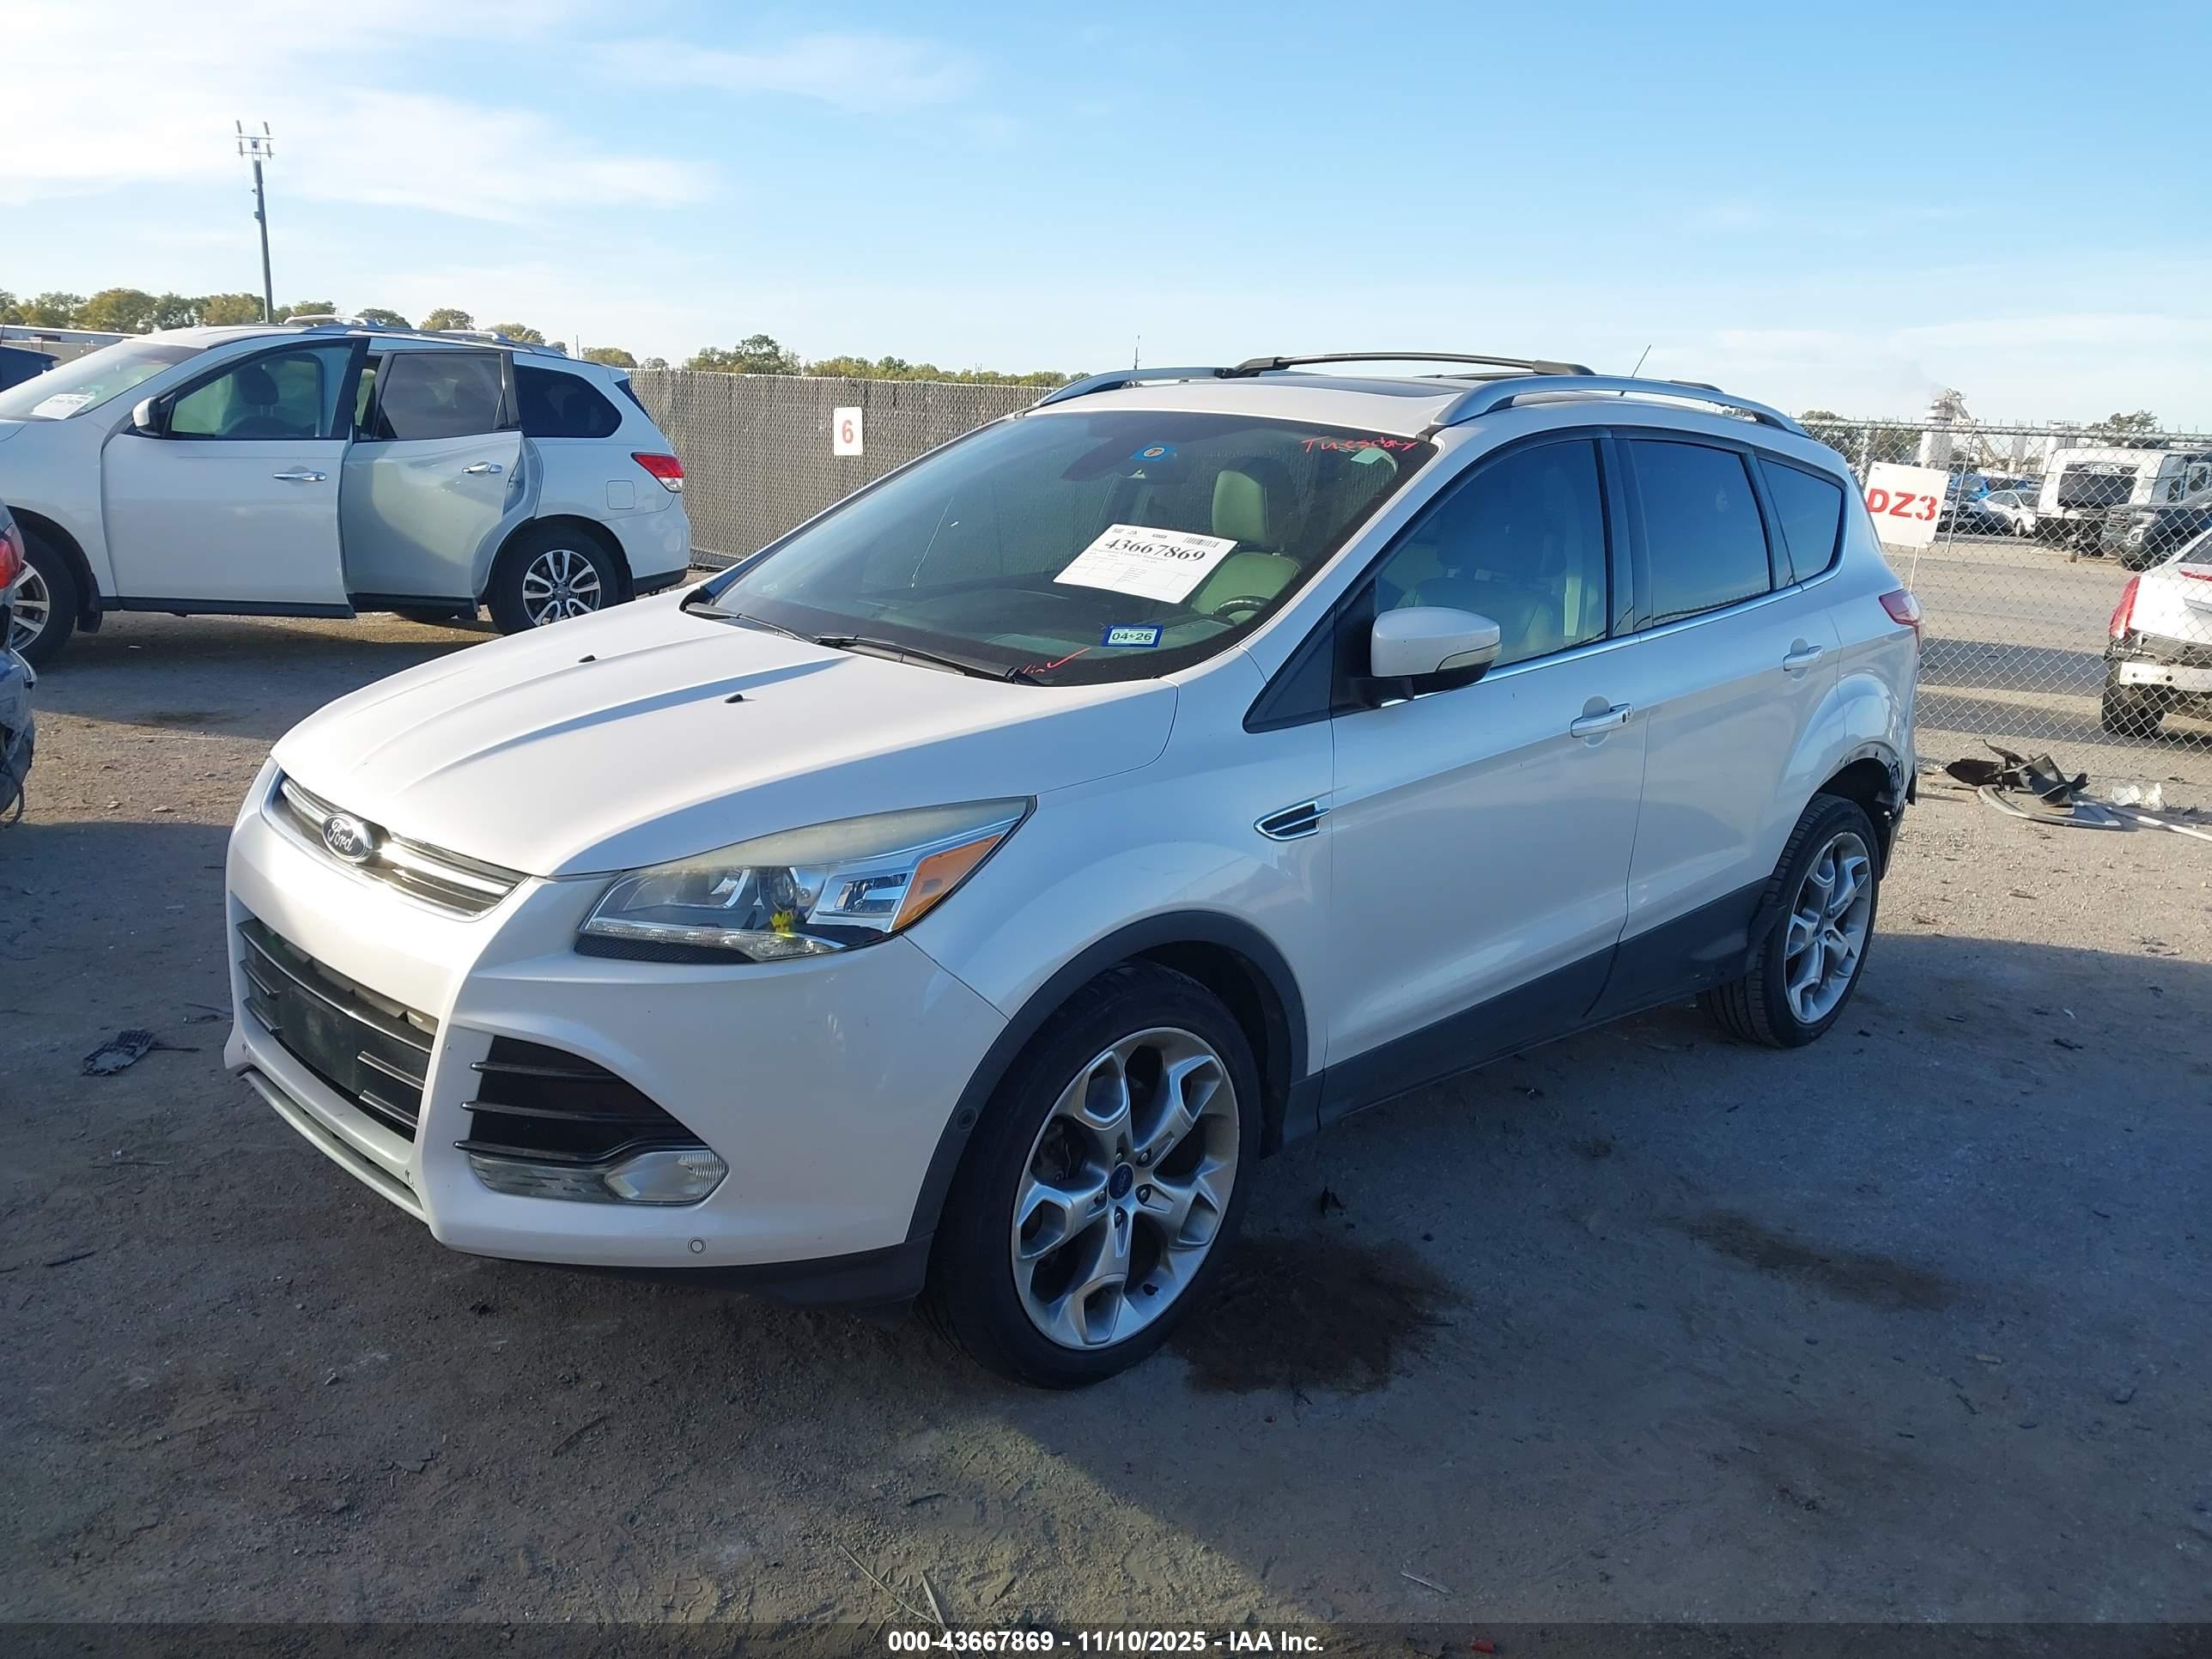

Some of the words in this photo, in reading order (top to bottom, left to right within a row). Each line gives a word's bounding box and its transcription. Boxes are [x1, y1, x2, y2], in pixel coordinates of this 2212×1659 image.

[842, 420, 854, 444] 6
[1301, 436, 1418, 453] Tuesday
[1868, 488, 1937, 520] DZ3
[1105, 538, 1206, 562] 43667869
[327, 818, 356, 852] Ford
